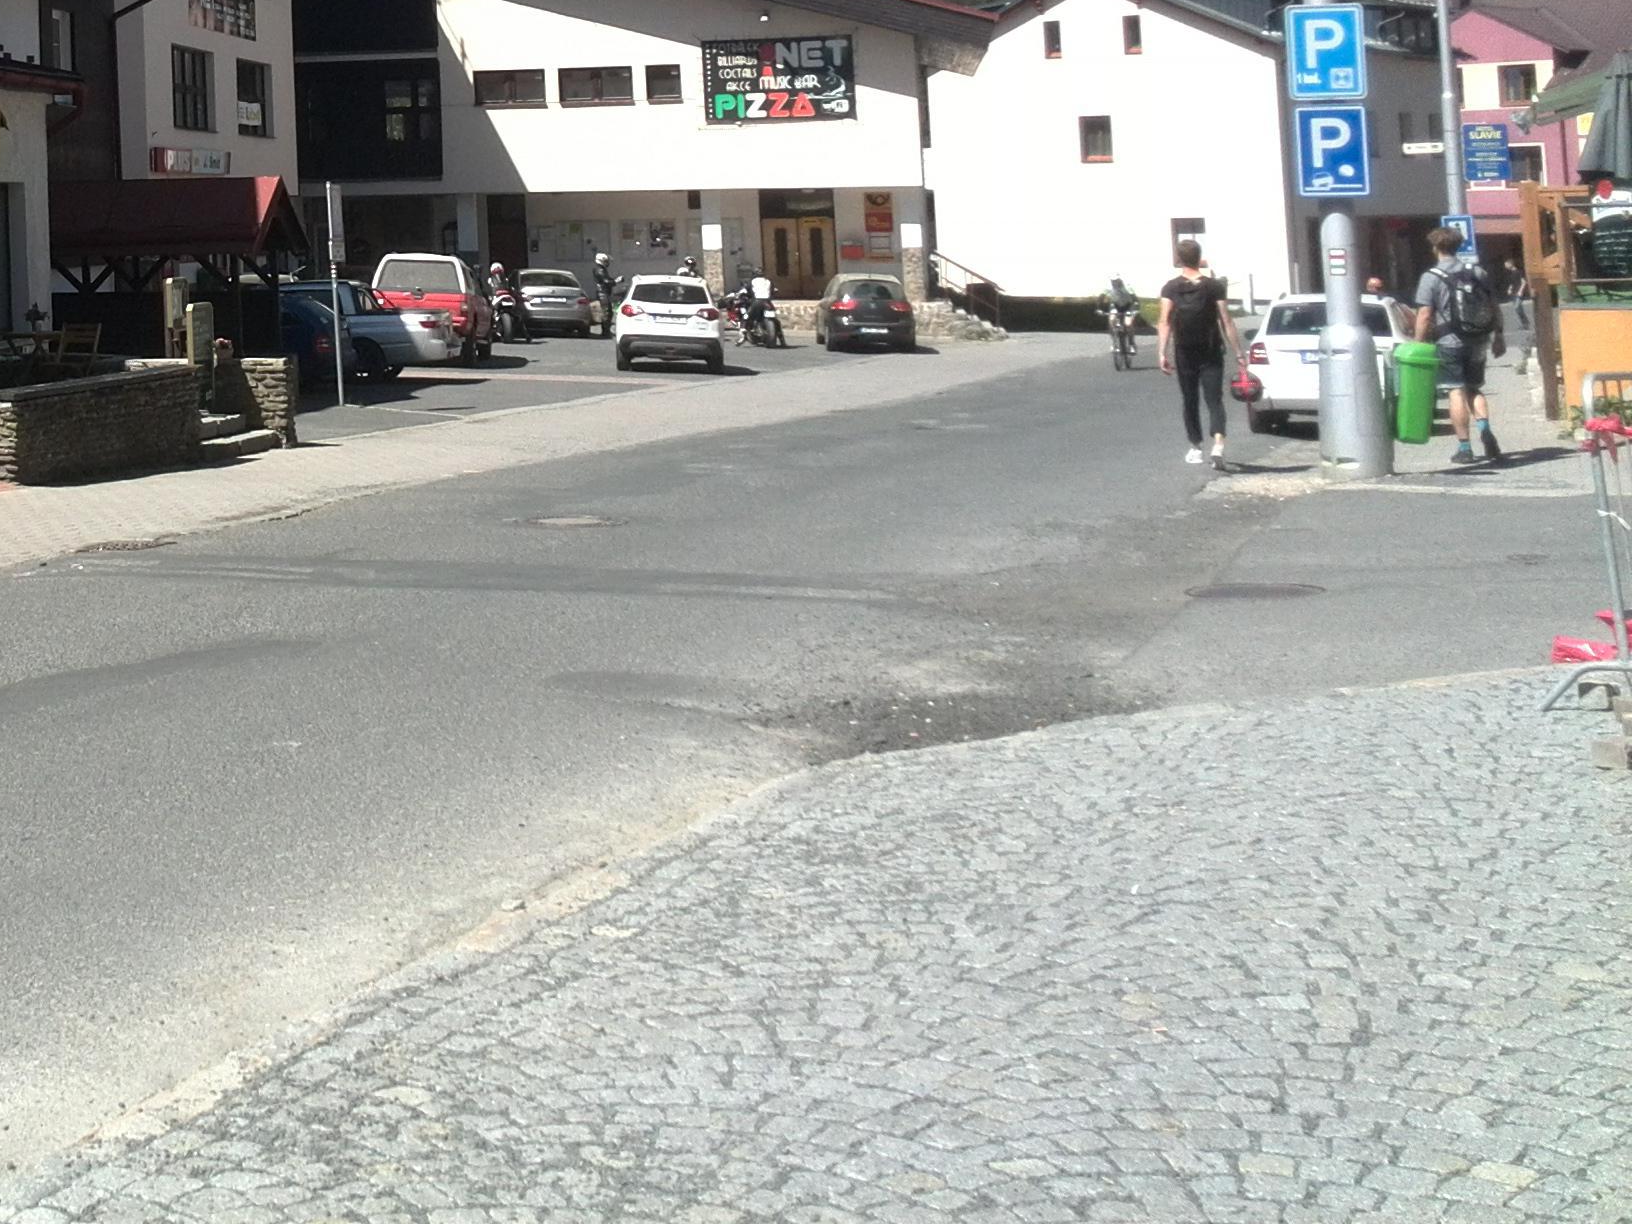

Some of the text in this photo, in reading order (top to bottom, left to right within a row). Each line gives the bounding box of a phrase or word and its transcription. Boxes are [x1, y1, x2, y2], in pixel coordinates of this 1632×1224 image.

[1303, 19, 1345, 69] P
[759, 75, 793, 90] MUSIC
[714, 92, 816, 119] PIZZA
[1310, 117, 1352, 168] P
